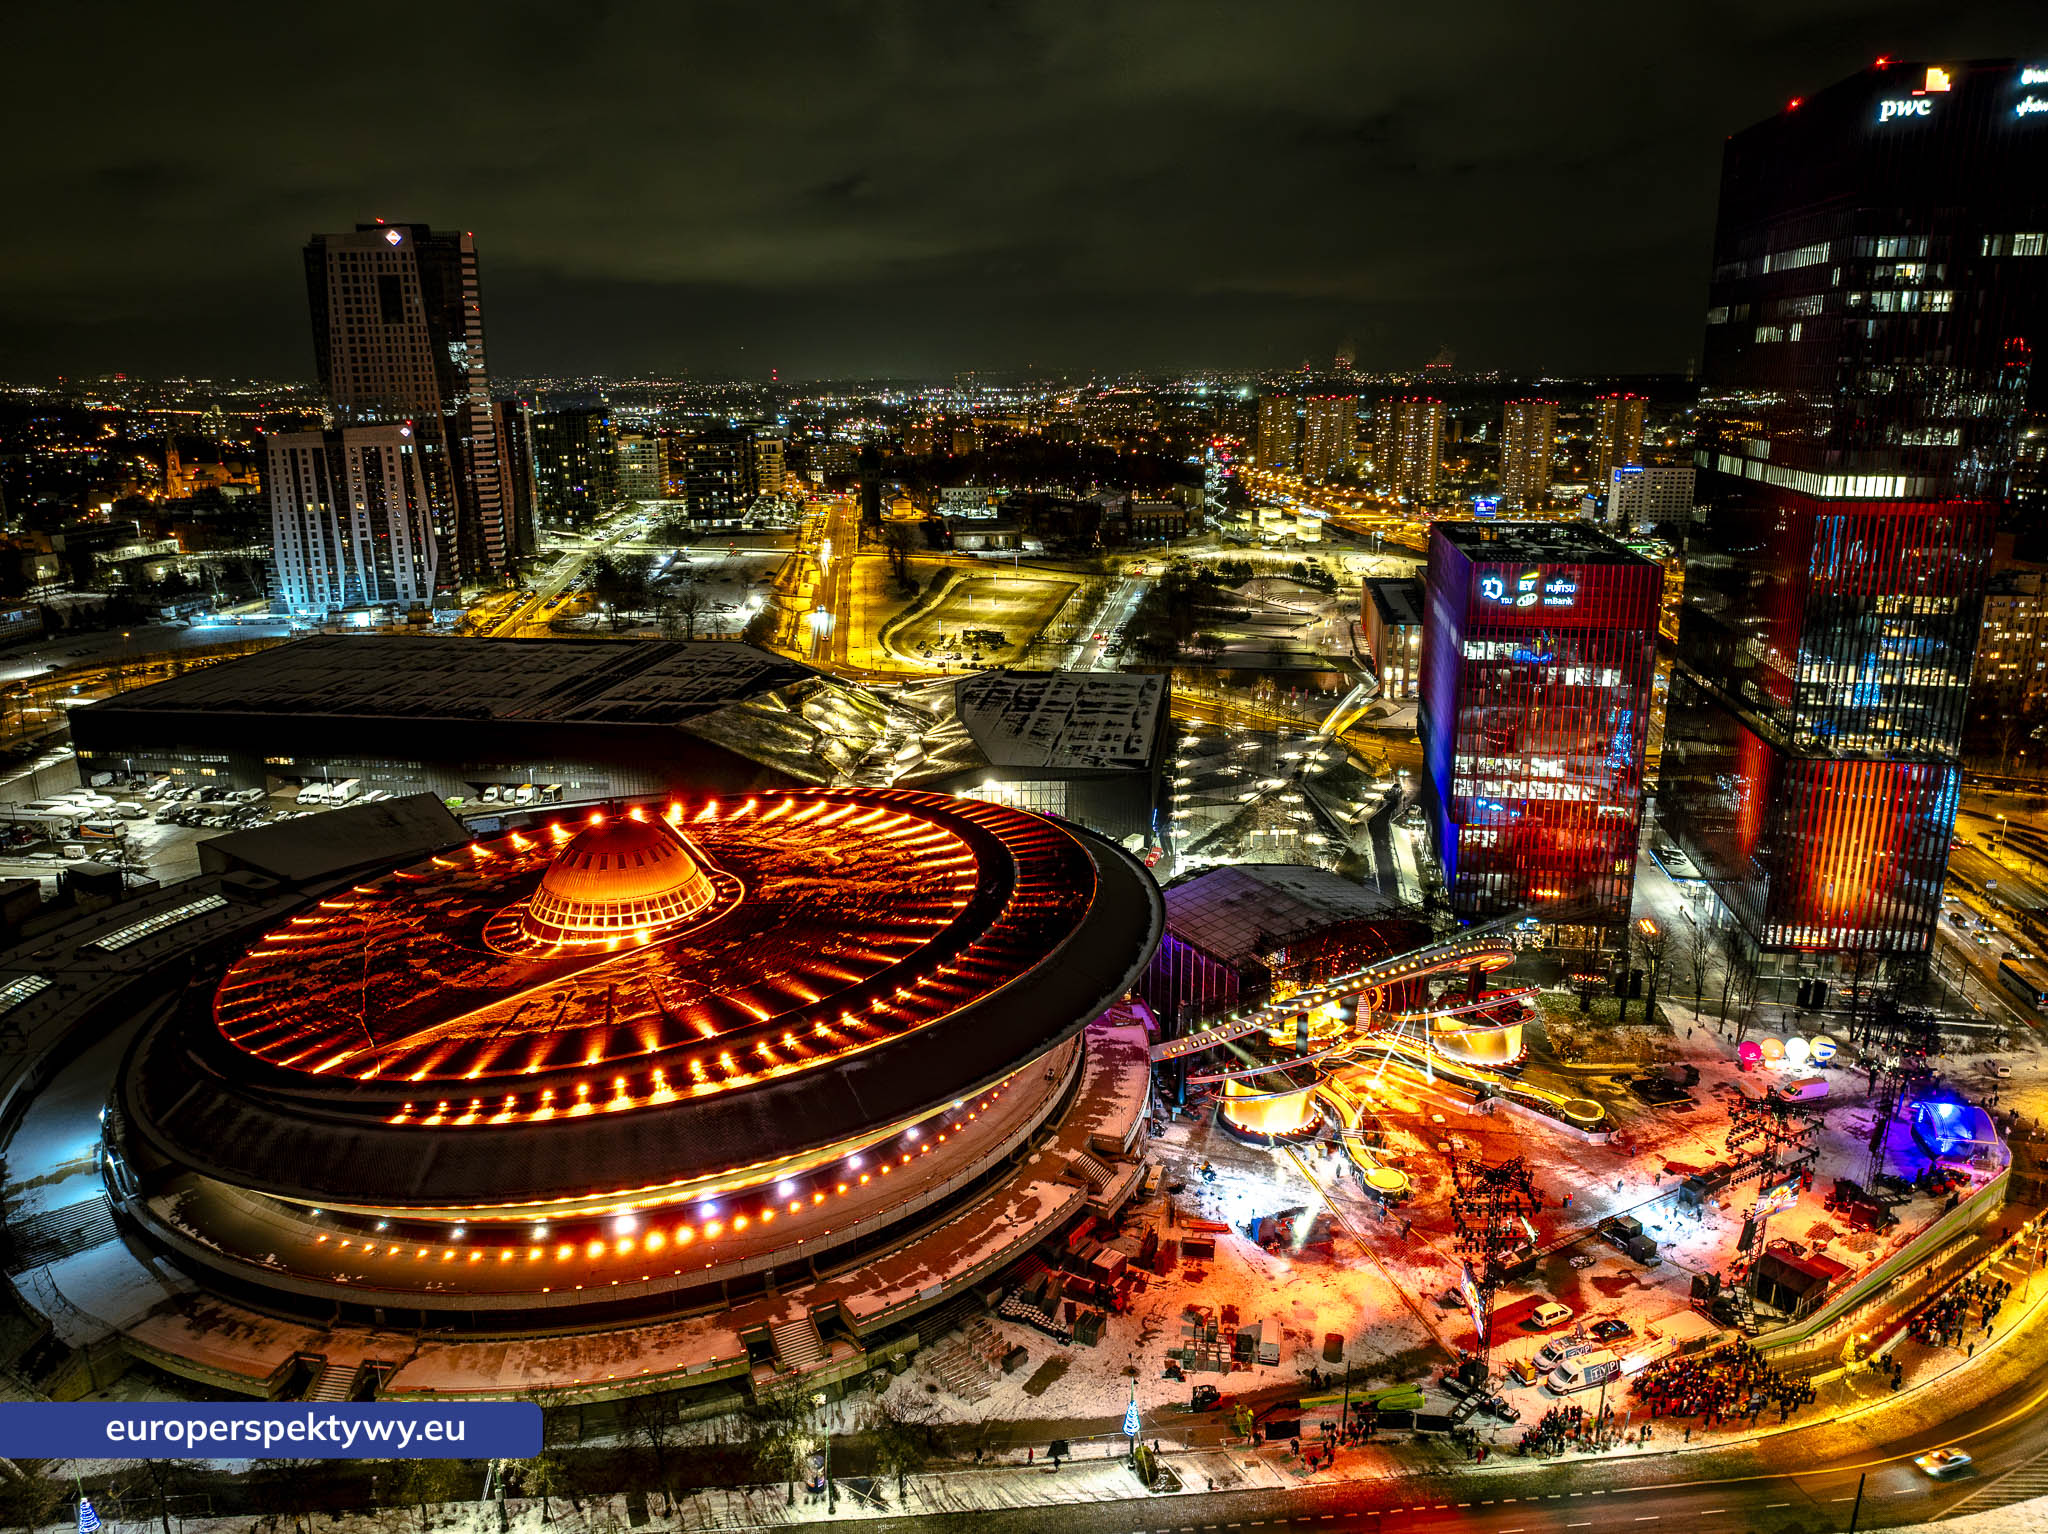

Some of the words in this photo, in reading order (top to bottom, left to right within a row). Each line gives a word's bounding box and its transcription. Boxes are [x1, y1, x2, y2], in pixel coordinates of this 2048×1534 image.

[1879, 99, 1931, 122] pwc
[1518, 580, 1536, 591] EY
[1545, 584, 1576, 594] FUJITSU
[1544, 597, 1574, 605] mBank
[1592, 1361, 1617, 1379] TVP
